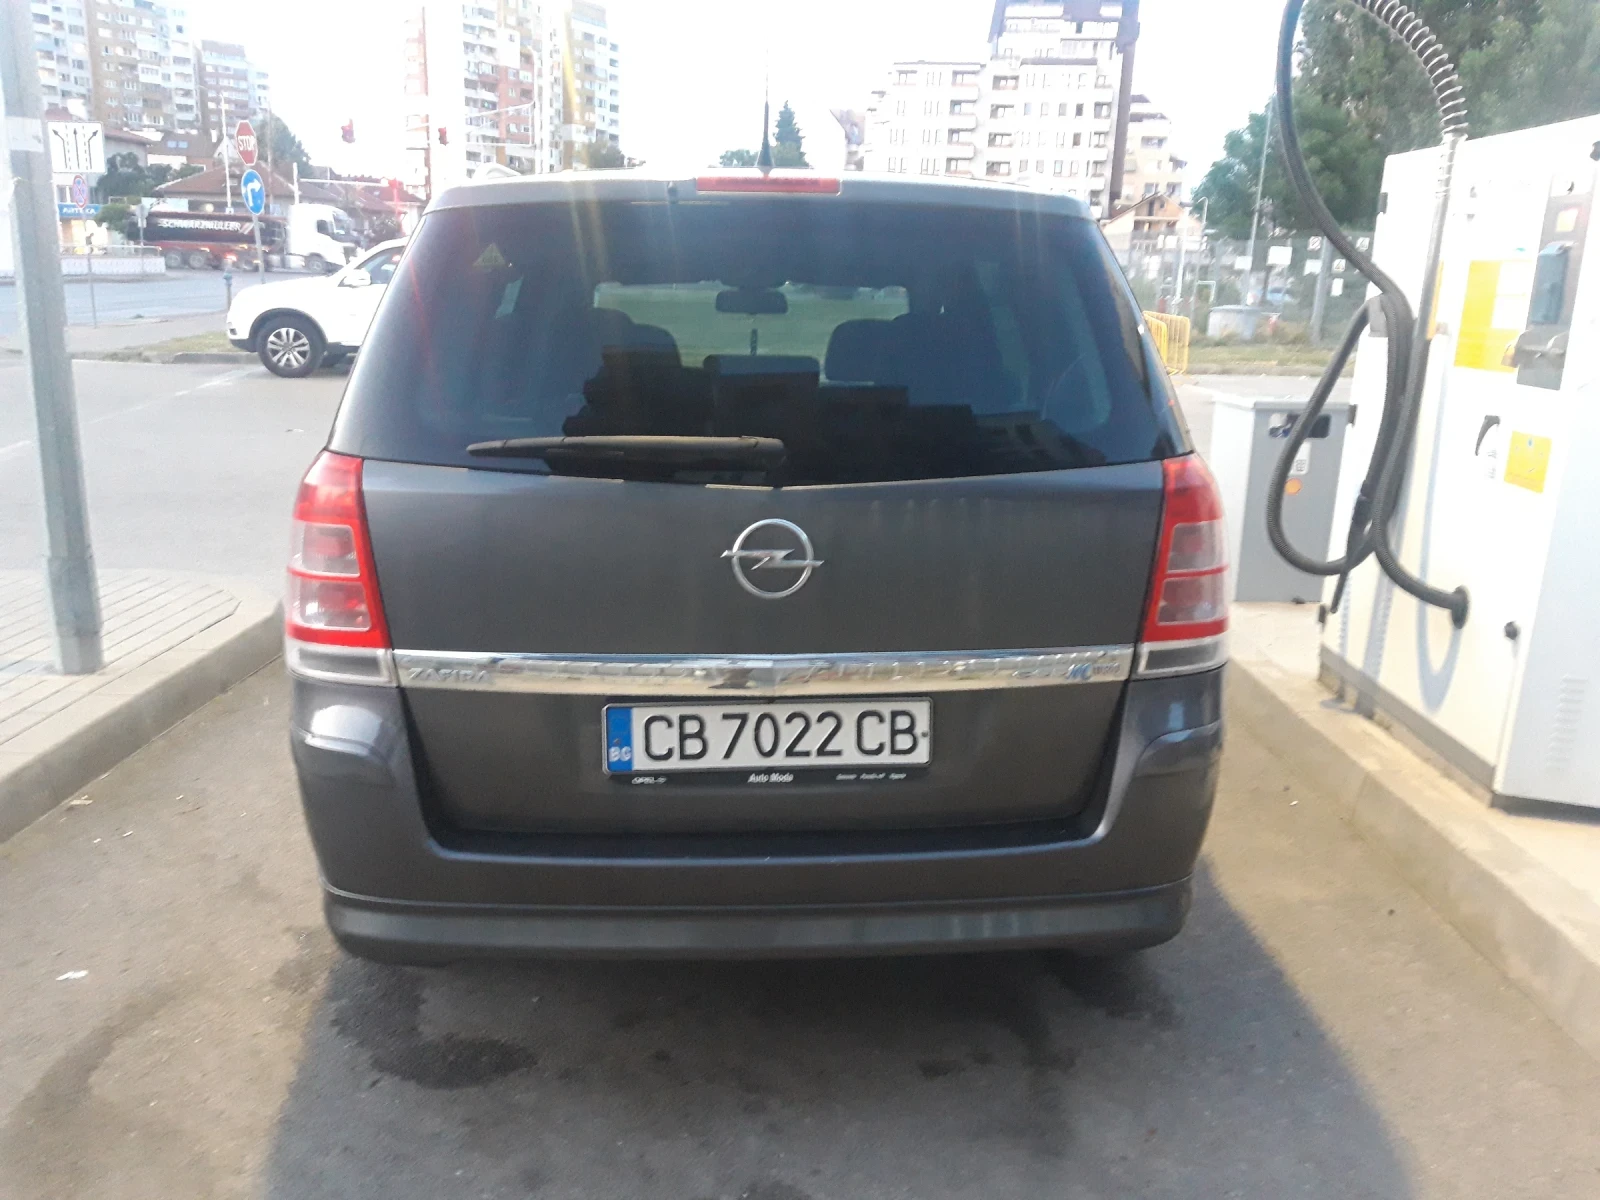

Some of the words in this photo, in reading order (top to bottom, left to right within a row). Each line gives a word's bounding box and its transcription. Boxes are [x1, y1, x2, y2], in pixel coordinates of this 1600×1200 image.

[237, 135, 256, 151] STOP
[643, 714, 709, 761] CB
[721, 710, 843, 759] 7022
[856, 709, 919, 757] CB
[608, 746, 631, 762] BG
